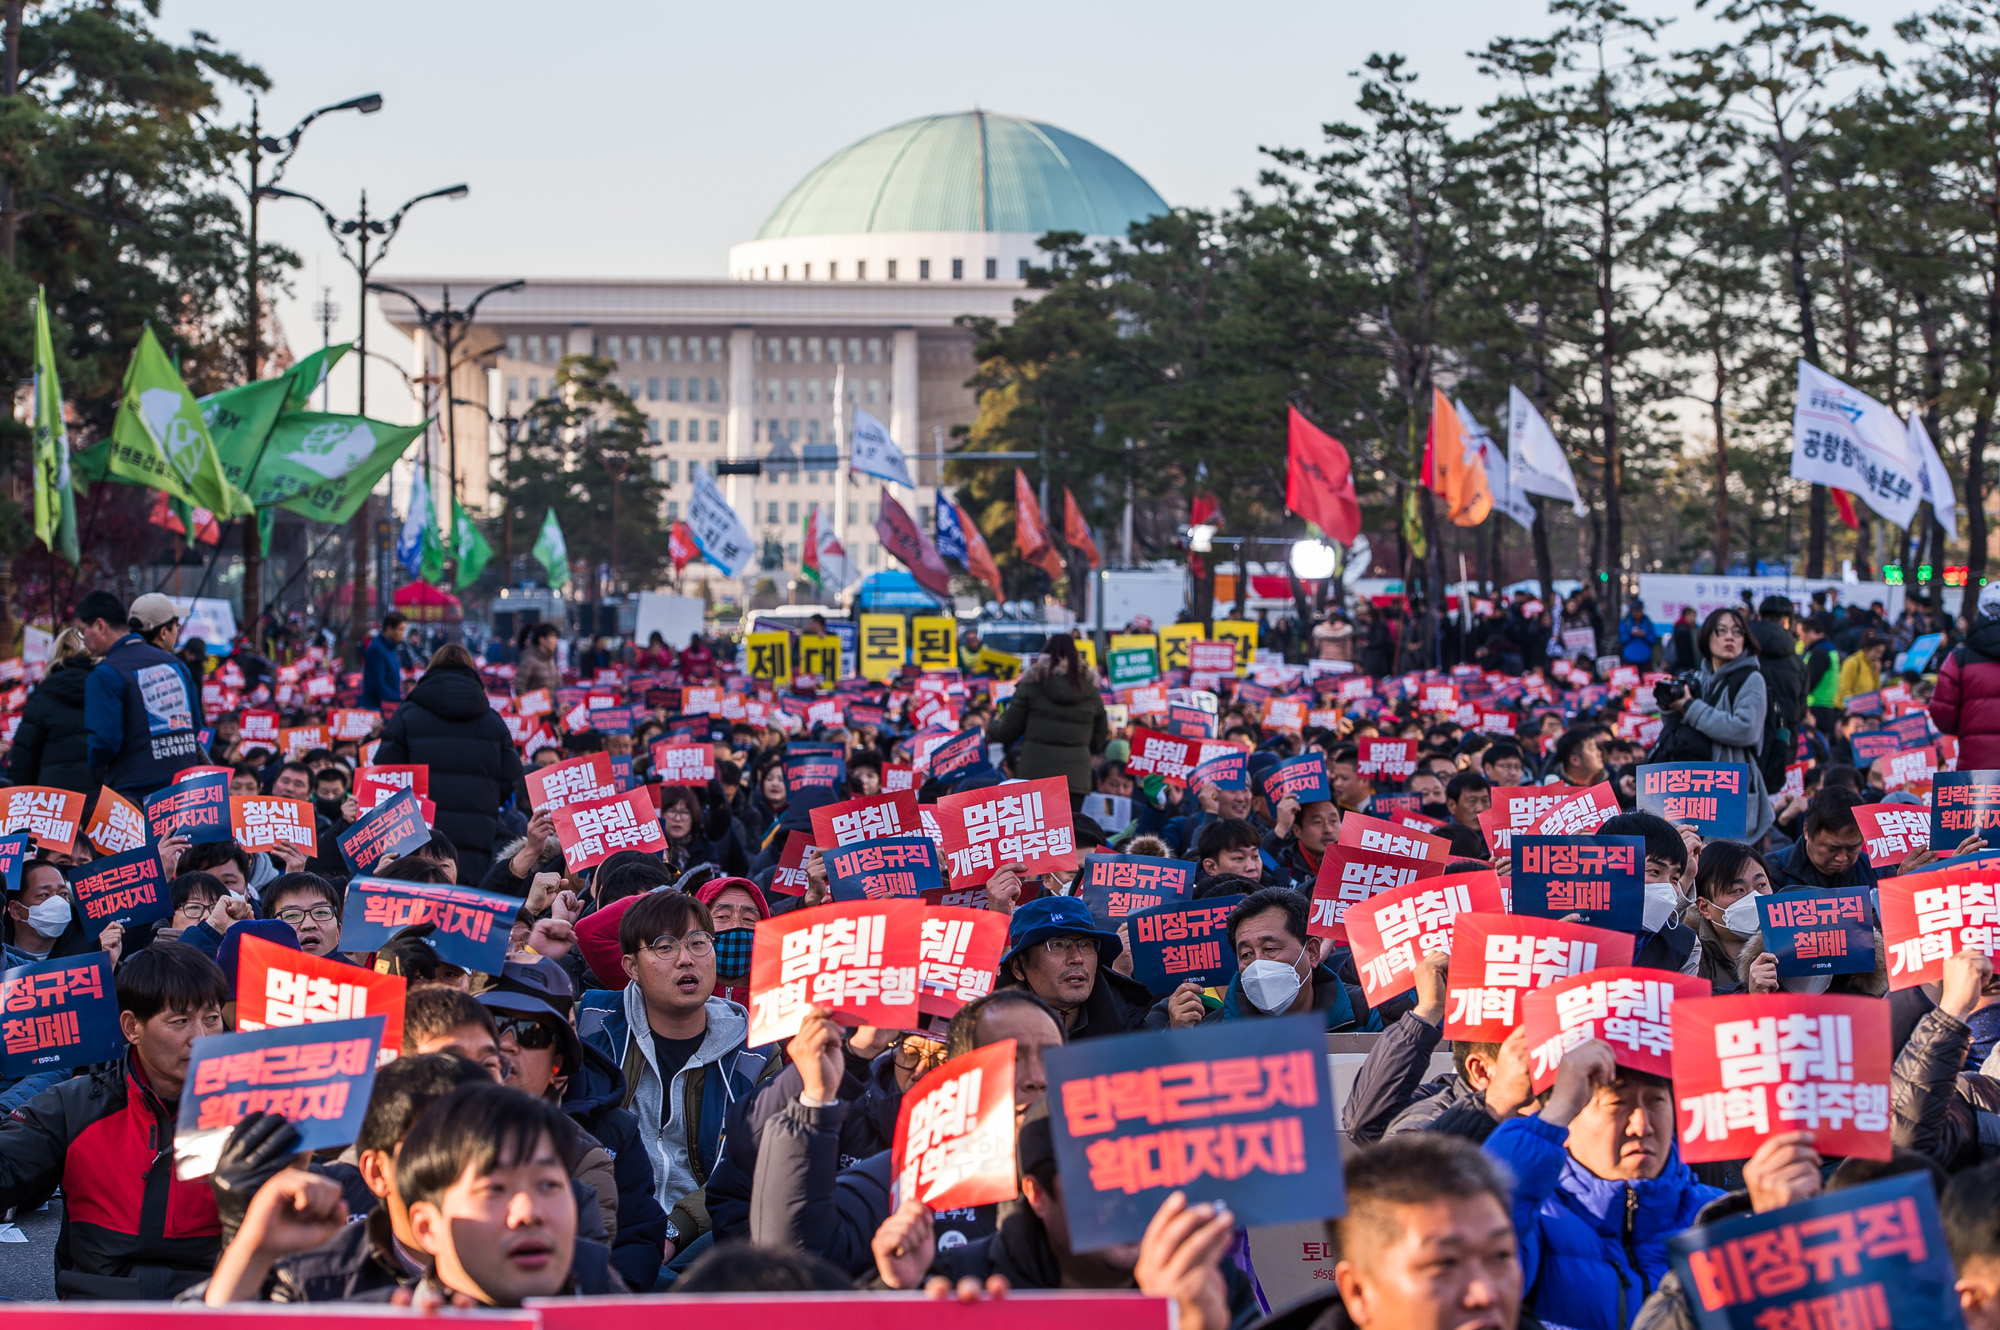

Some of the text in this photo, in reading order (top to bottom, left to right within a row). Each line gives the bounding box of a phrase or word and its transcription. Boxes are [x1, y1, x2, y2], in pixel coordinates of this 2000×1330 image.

[751, 643, 785, 678] 제
[866, 627, 900, 659] 로
[919, 630, 950, 662] 된
[805, 648, 836, 682] 대
[666, 748, 704, 768] 멈춰!
[1128, 755, 1155, 773] 개혁
[1144, 738, 1188, 764] 멈춰!
[1358, 761, 1417, 774] 개혁 역주행
[1370, 743, 1407, 761] 멈춰!
[542, 762, 597, 800] 멈춰!
[1263, 760, 1322, 794] 탄력근로제
[1645, 769, 1739, 795] 비정규직
[8, 792, 67, 819] 청산!
[148, 784, 223, 821] 탄력근로제
[242, 801, 299, 826] 청산!
[571, 800, 637, 840] 멈춰!
[963, 791, 1045, 845] 멈춰!
[1663, 797, 1717, 822] 철폐!
[152, 806, 219, 838] 확대저지!
[235, 824, 312, 848] 사법적폐
[343, 797, 415, 858] 탄력근로제
[831, 801, 901, 847] 멈춰!
[355, 818, 416, 870] 확대저지!
[564, 818, 661, 866] 개혁 역주행
[947, 827, 1073, 880] 개혁 역주행
[1522, 845, 1635, 876] 비정규직
[1867, 835, 1908, 860] 개혁
[75, 858, 158, 900] 탄력근로제
[833, 844, 930, 880] 비정규직
[1091, 862, 1187, 894] 비정규직
[85, 883, 157, 919] 확대저지!
[860, 871, 916, 900] 철폐!
[1546, 880, 1611, 911] 철폐!
[363, 895, 494, 943] 확대저지!
[1373, 884, 1472, 951] 멈춰!
[1766, 896, 1864, 928] 비정규직
[781, 914, 886, 983] 멈춰!
[1161, 941, 1222, 974] 철폐!
[1794, 929, 1848, 960] 철폐!
[1888, 930, 1954, 977] 개혁
[1361, 946, 1417, 994] 개혁
[752, 966, 917, 1031] 개혁 역주행
[1448, 987, 1517, 1026] 개혁
[1555, 978, 1674, 1032] 멈춰!
[2, 1010, 81, 1055] 철폐!
[1603, 1017, 1674, 1057] 역주
[1714, 1013, 1855, 1089] 멈춰!
[193, 1037, 373, 1096] 탄력근로제
[197, 1081, 350, 1131] 확대저지!
[1060, 1050, 1319, 1138] 탄력근로제
[1680, 1081, 1891, 1144] 개혁 역주행
[905, 1067, 983, 1166] 멈춰!
[1086, 1114, 1307, 1195] 확대저지!
[1688, 1196, 1928, 1312] 비정규직
